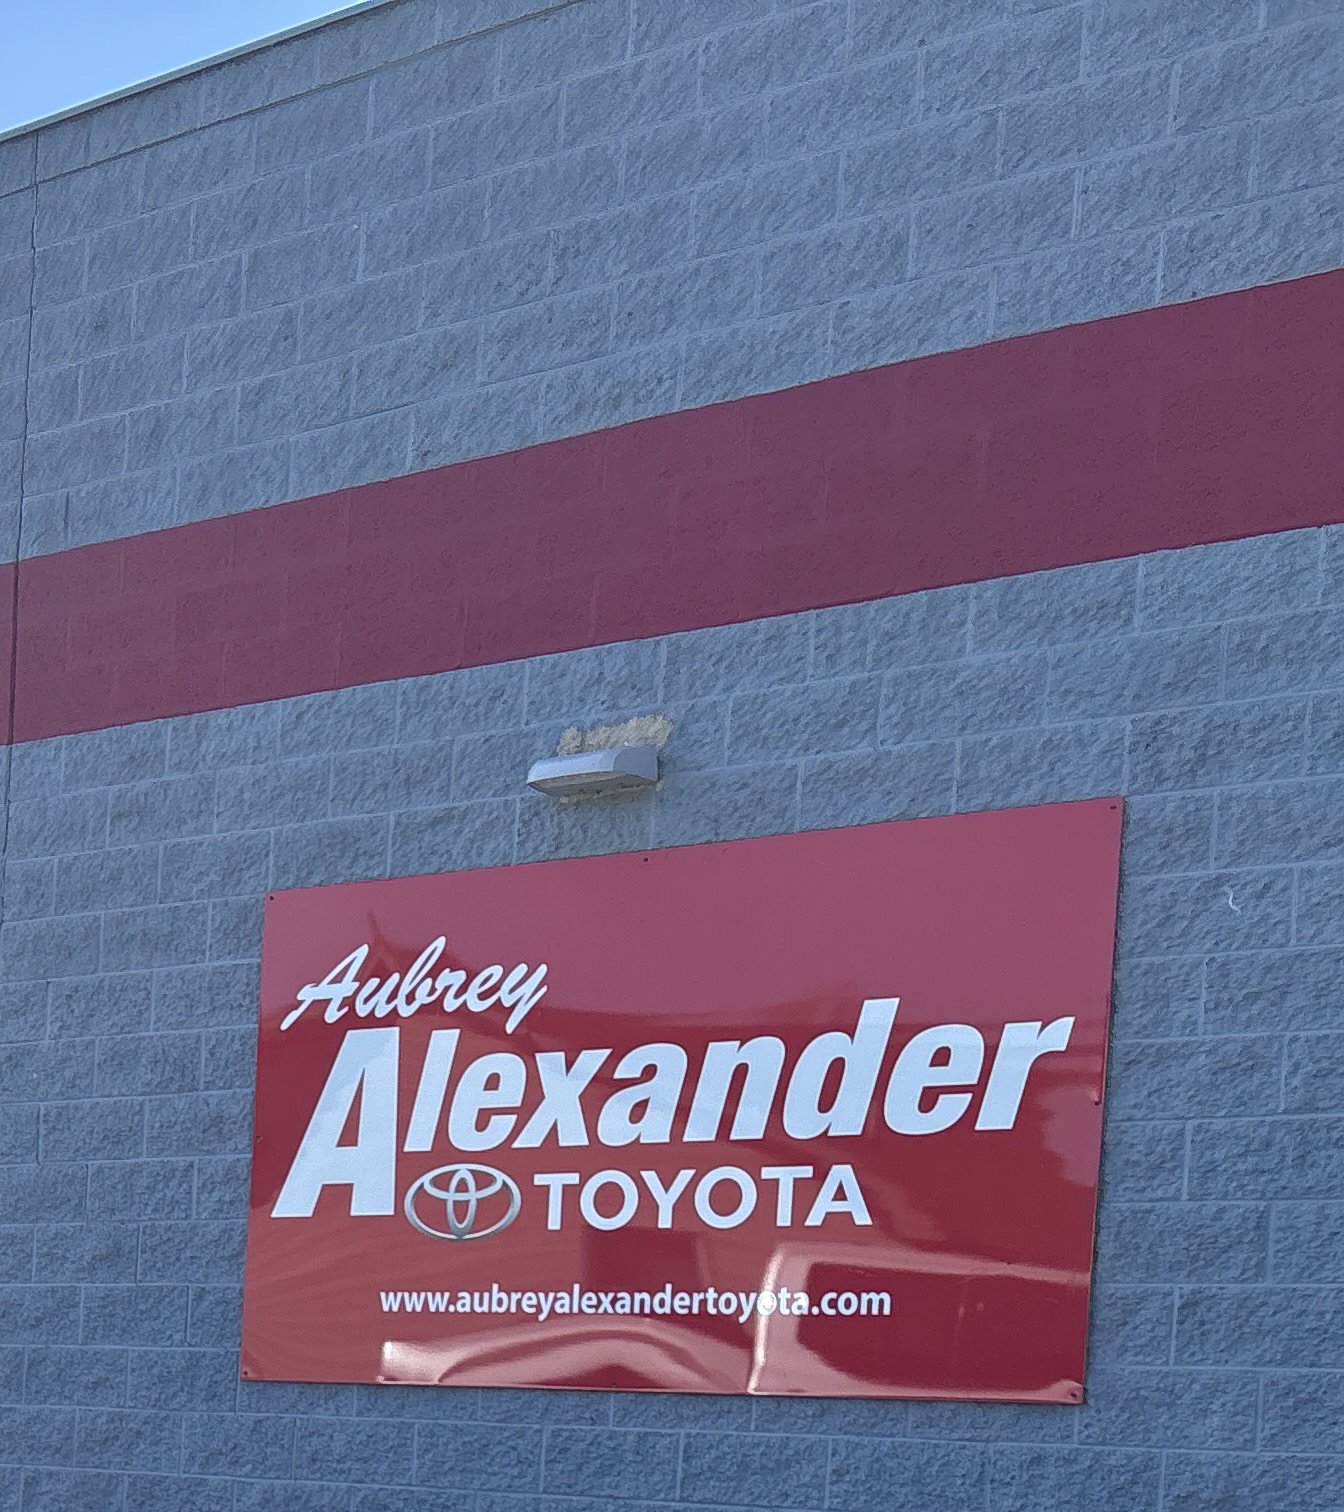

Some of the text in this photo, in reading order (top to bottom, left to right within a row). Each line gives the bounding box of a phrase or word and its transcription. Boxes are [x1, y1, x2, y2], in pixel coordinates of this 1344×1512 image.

[281, 936, 547, 1033] Aubrey
[272, 998, 1075, 1217] Alexander
[534, 1165, 872, 1230] TOYOTA
[380, 1284, 890, 1322] www.aubreyalexandertoyota.com
